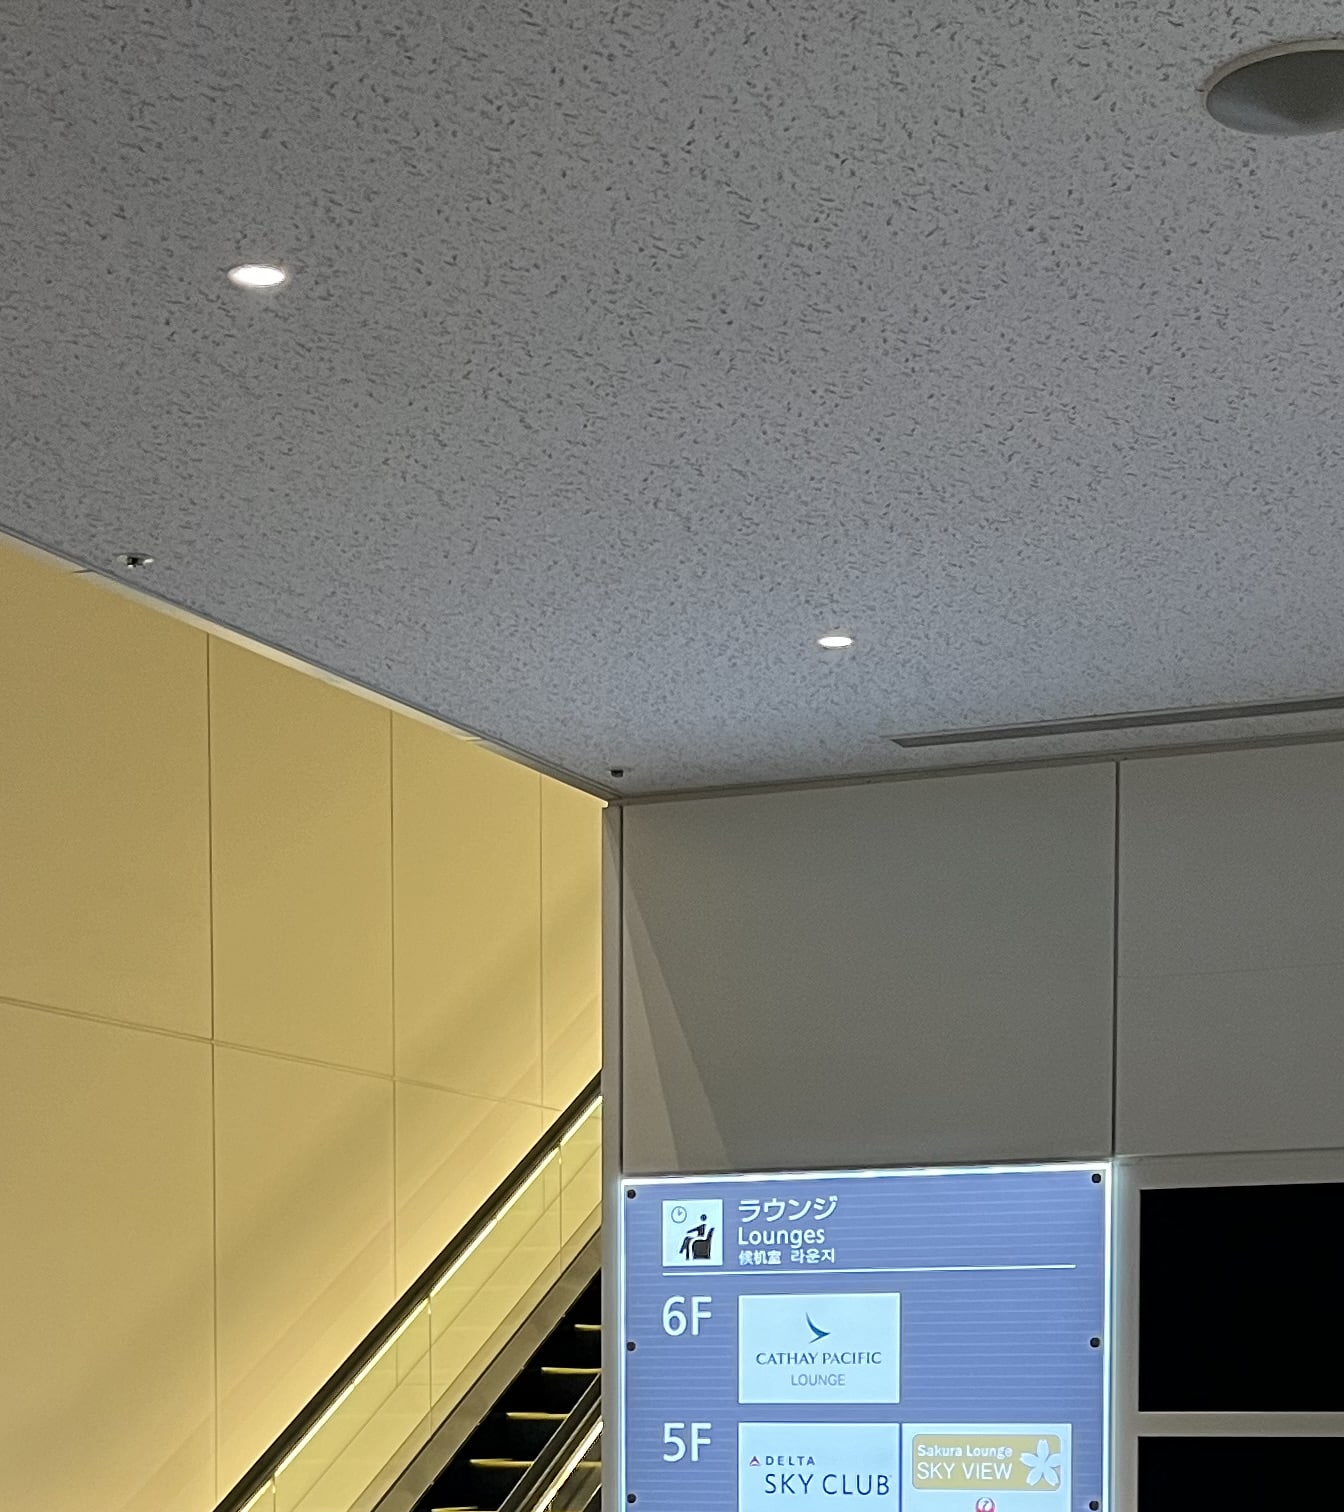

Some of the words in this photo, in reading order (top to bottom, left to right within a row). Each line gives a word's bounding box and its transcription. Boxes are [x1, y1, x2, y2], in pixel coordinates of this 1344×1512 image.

[738, 1196, 837, 1222] ラウンジ
[738, 1227, 825, 1247] Lounges
[791, 1249, 834, 1264] 라운지
[663, 1296, 712, 1336] 6F
[756, 1353, 819, 1364] CATHAY
[823, 1352, 881, 1364] PACIFIC
[791, 1374, 845, 1385] LOUNGE
[663, 1422, 712, 1462] 5F
[765, 1456, 815, 1466] DELTA
[918, 1446, 962, 1457] Sakura
[966, 1446, 1012, 1459] Lounge
[917, 1463, 954, 1479] SKY
[962, 1463, 1012, 1480] VIEW
[765, 1474, 813, 1494] SKY
[823, 1475, 889, 1494] CLUB
